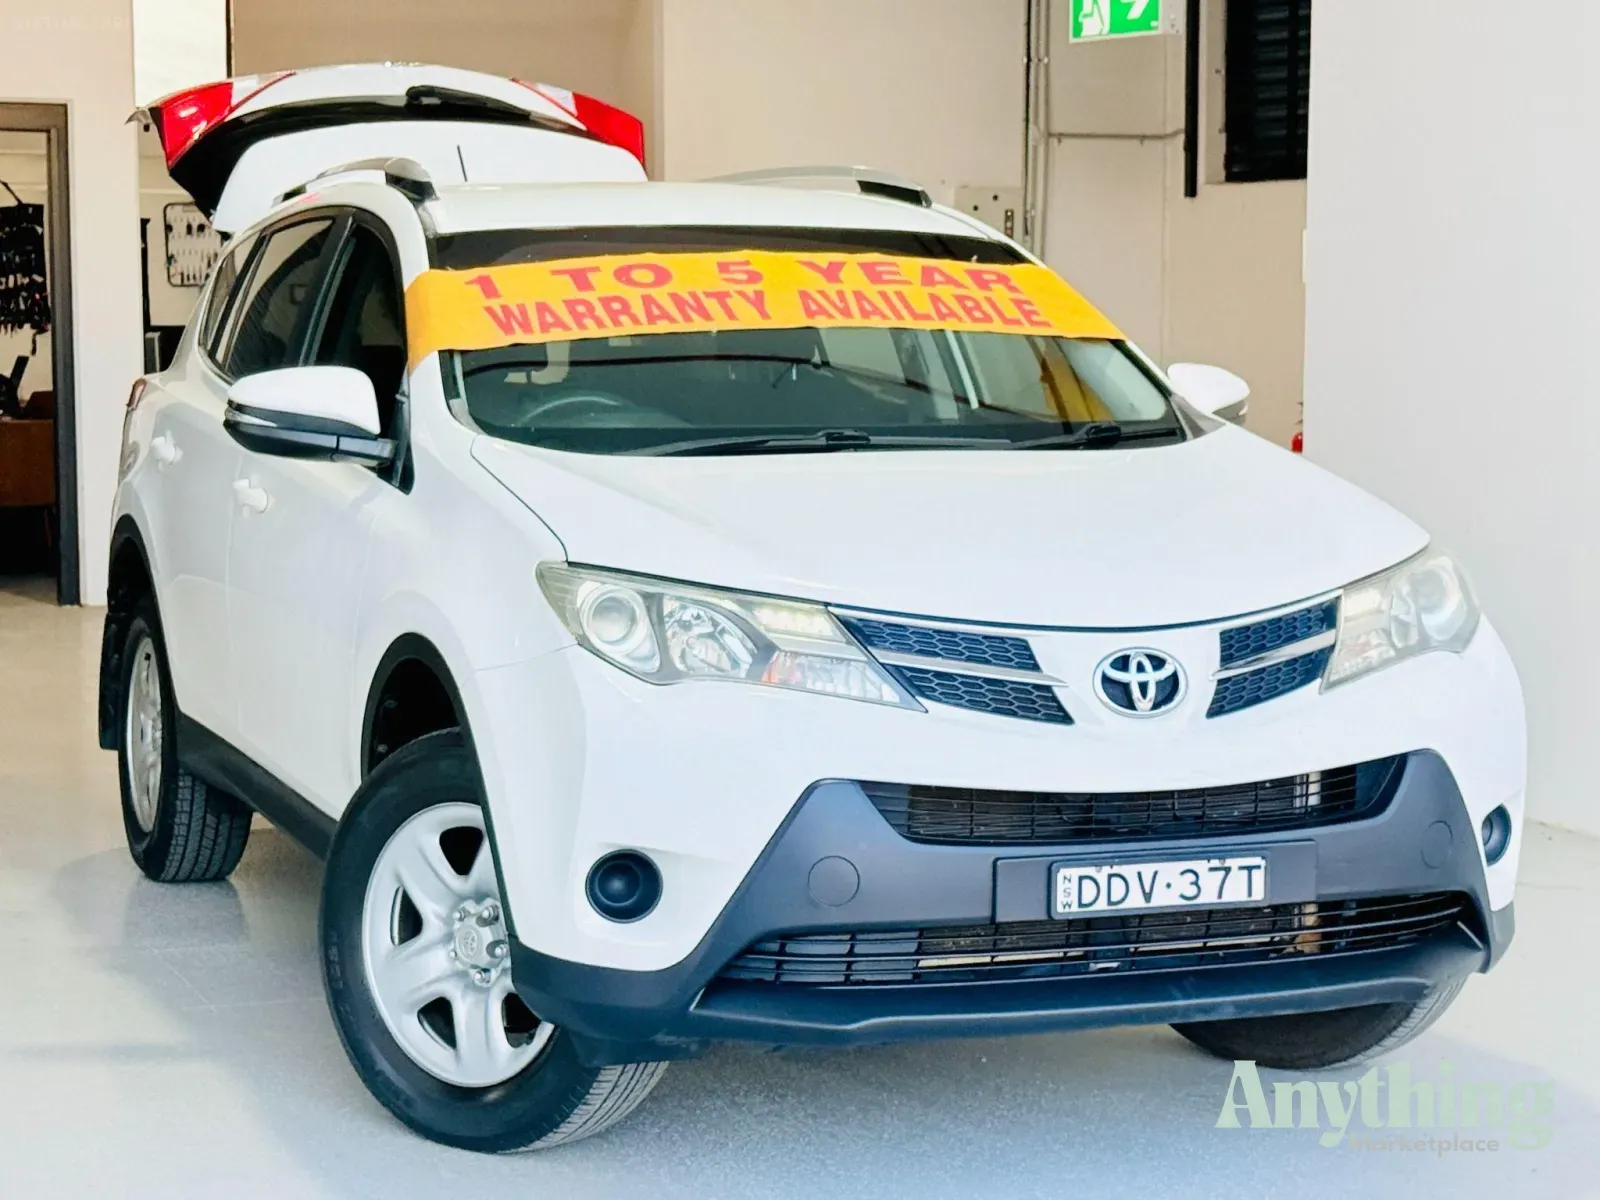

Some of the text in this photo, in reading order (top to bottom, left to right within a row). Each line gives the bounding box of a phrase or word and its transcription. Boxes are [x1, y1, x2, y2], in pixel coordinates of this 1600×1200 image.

[464, 260, 1024, 299] 1 TO 5 YEAR
[483, 289, 1052, 336] WARRANTY AVAILABLE
